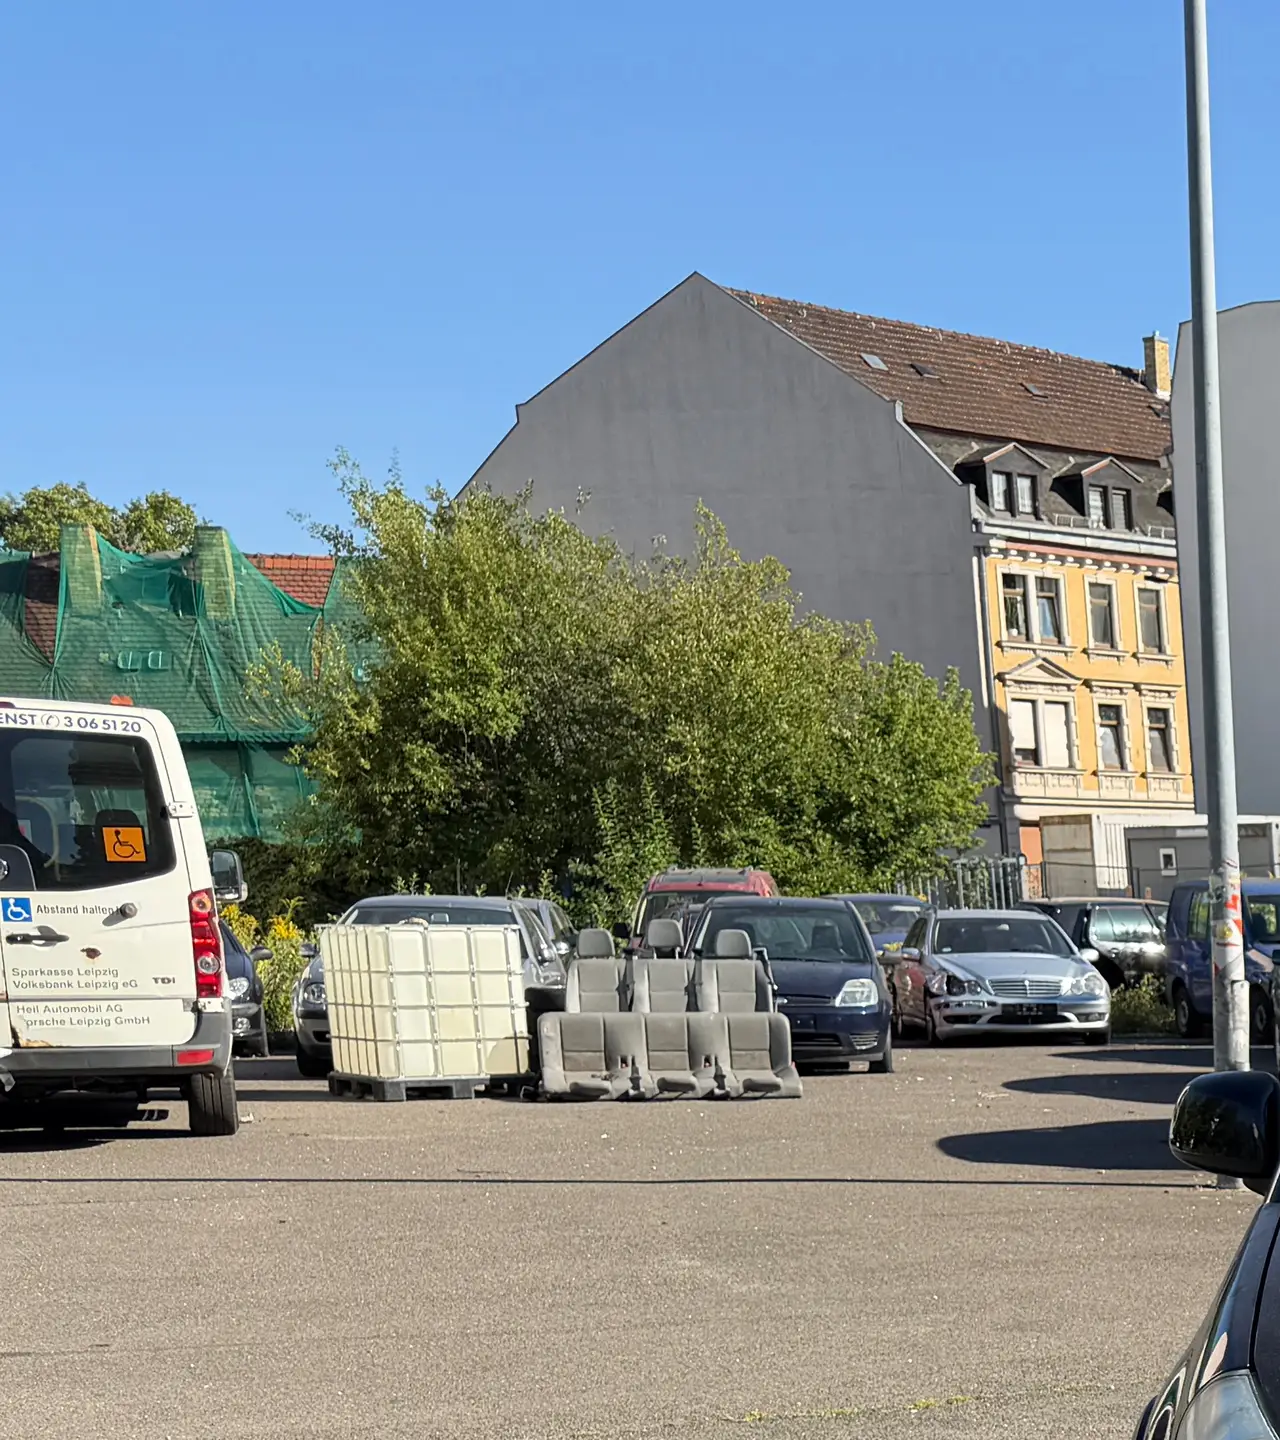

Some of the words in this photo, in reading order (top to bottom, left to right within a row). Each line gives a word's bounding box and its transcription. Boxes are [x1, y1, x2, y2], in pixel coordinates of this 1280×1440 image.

[64, 716, 73, 727] 3
[77, 717, 98, 729] 06
[121, 721, 141, 733] 20
[37, 904, 78, 914] Abstand
[12, 968, 74, 978] Sparkasse
[78, 968, 119, 978] Leipzig
[13, 980, 74, 989] Volksbank
[78, 980, 119, 990] Leipzig
[122, 980, 138, 988] eG
[16, 1005, 39, 1013] Heil
[43, 1005, 102, 1013] Automobil
[106, 1004, 123, 1012] AG
[70, 1017, 111, 1027] Leipzig
[115, 1016, 150, 1024] GmbH
